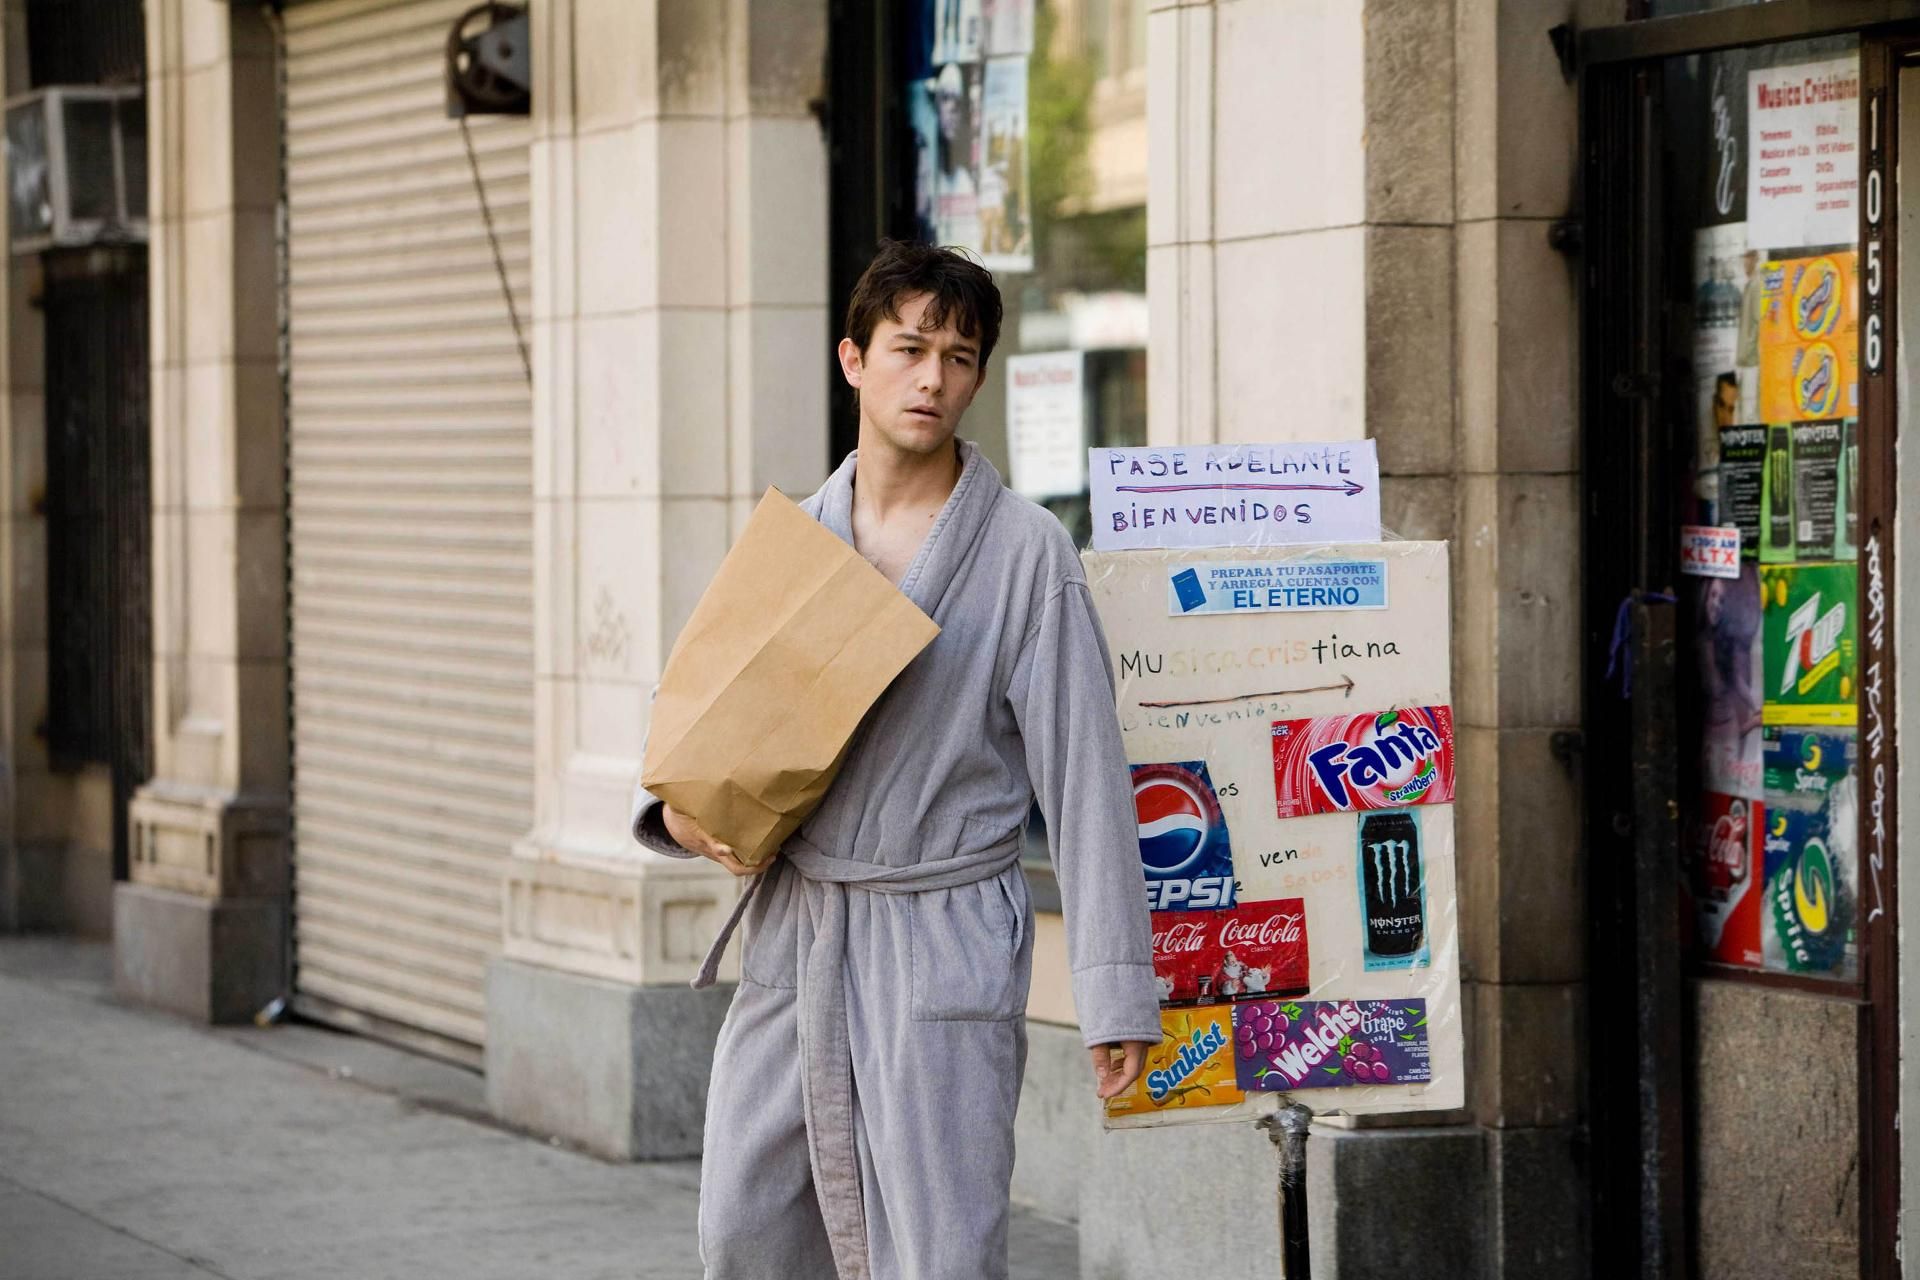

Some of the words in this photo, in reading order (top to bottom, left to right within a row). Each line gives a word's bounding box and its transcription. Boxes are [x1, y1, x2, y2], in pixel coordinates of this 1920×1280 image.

[1110, 451, 1188, 476] PASE
[1684, 548, 1735, 565] KLTX
[1208, 580, 1217, 590] Y
[1221, 578, 1283, 590] ARREGLA
[1287, 576, 1350, 588] CUENTAS
[1352, 575, 1380, 587] CON
[1211, 567, 1273, 579] PREPARA
[1277, 566, 1295, 576] TU
[1299, 565, 1377, 576] PASAPORTE
[1234, 590, 1261, 608] EL
[1268, 587, 1359, 606] ETERNO
[1308, 722, 1440, 808] Fanta
[1389, 767, 1437, 801] Strawberry
[1794, 768, 1828, 791] Sprite
[1146, 876, 1234, 910] EPSI
[1370, 914, 1421, 928] MONSTER
[1778, 868, 1809, 963] Sprite
[1219, 913, 1304, 948] Coca-Cola
[1250, 945, 1272, 953] classic
[1361, 1010, 1407, 1043] Grape
[1146, 1020, 1227, 1100] Sunkist
